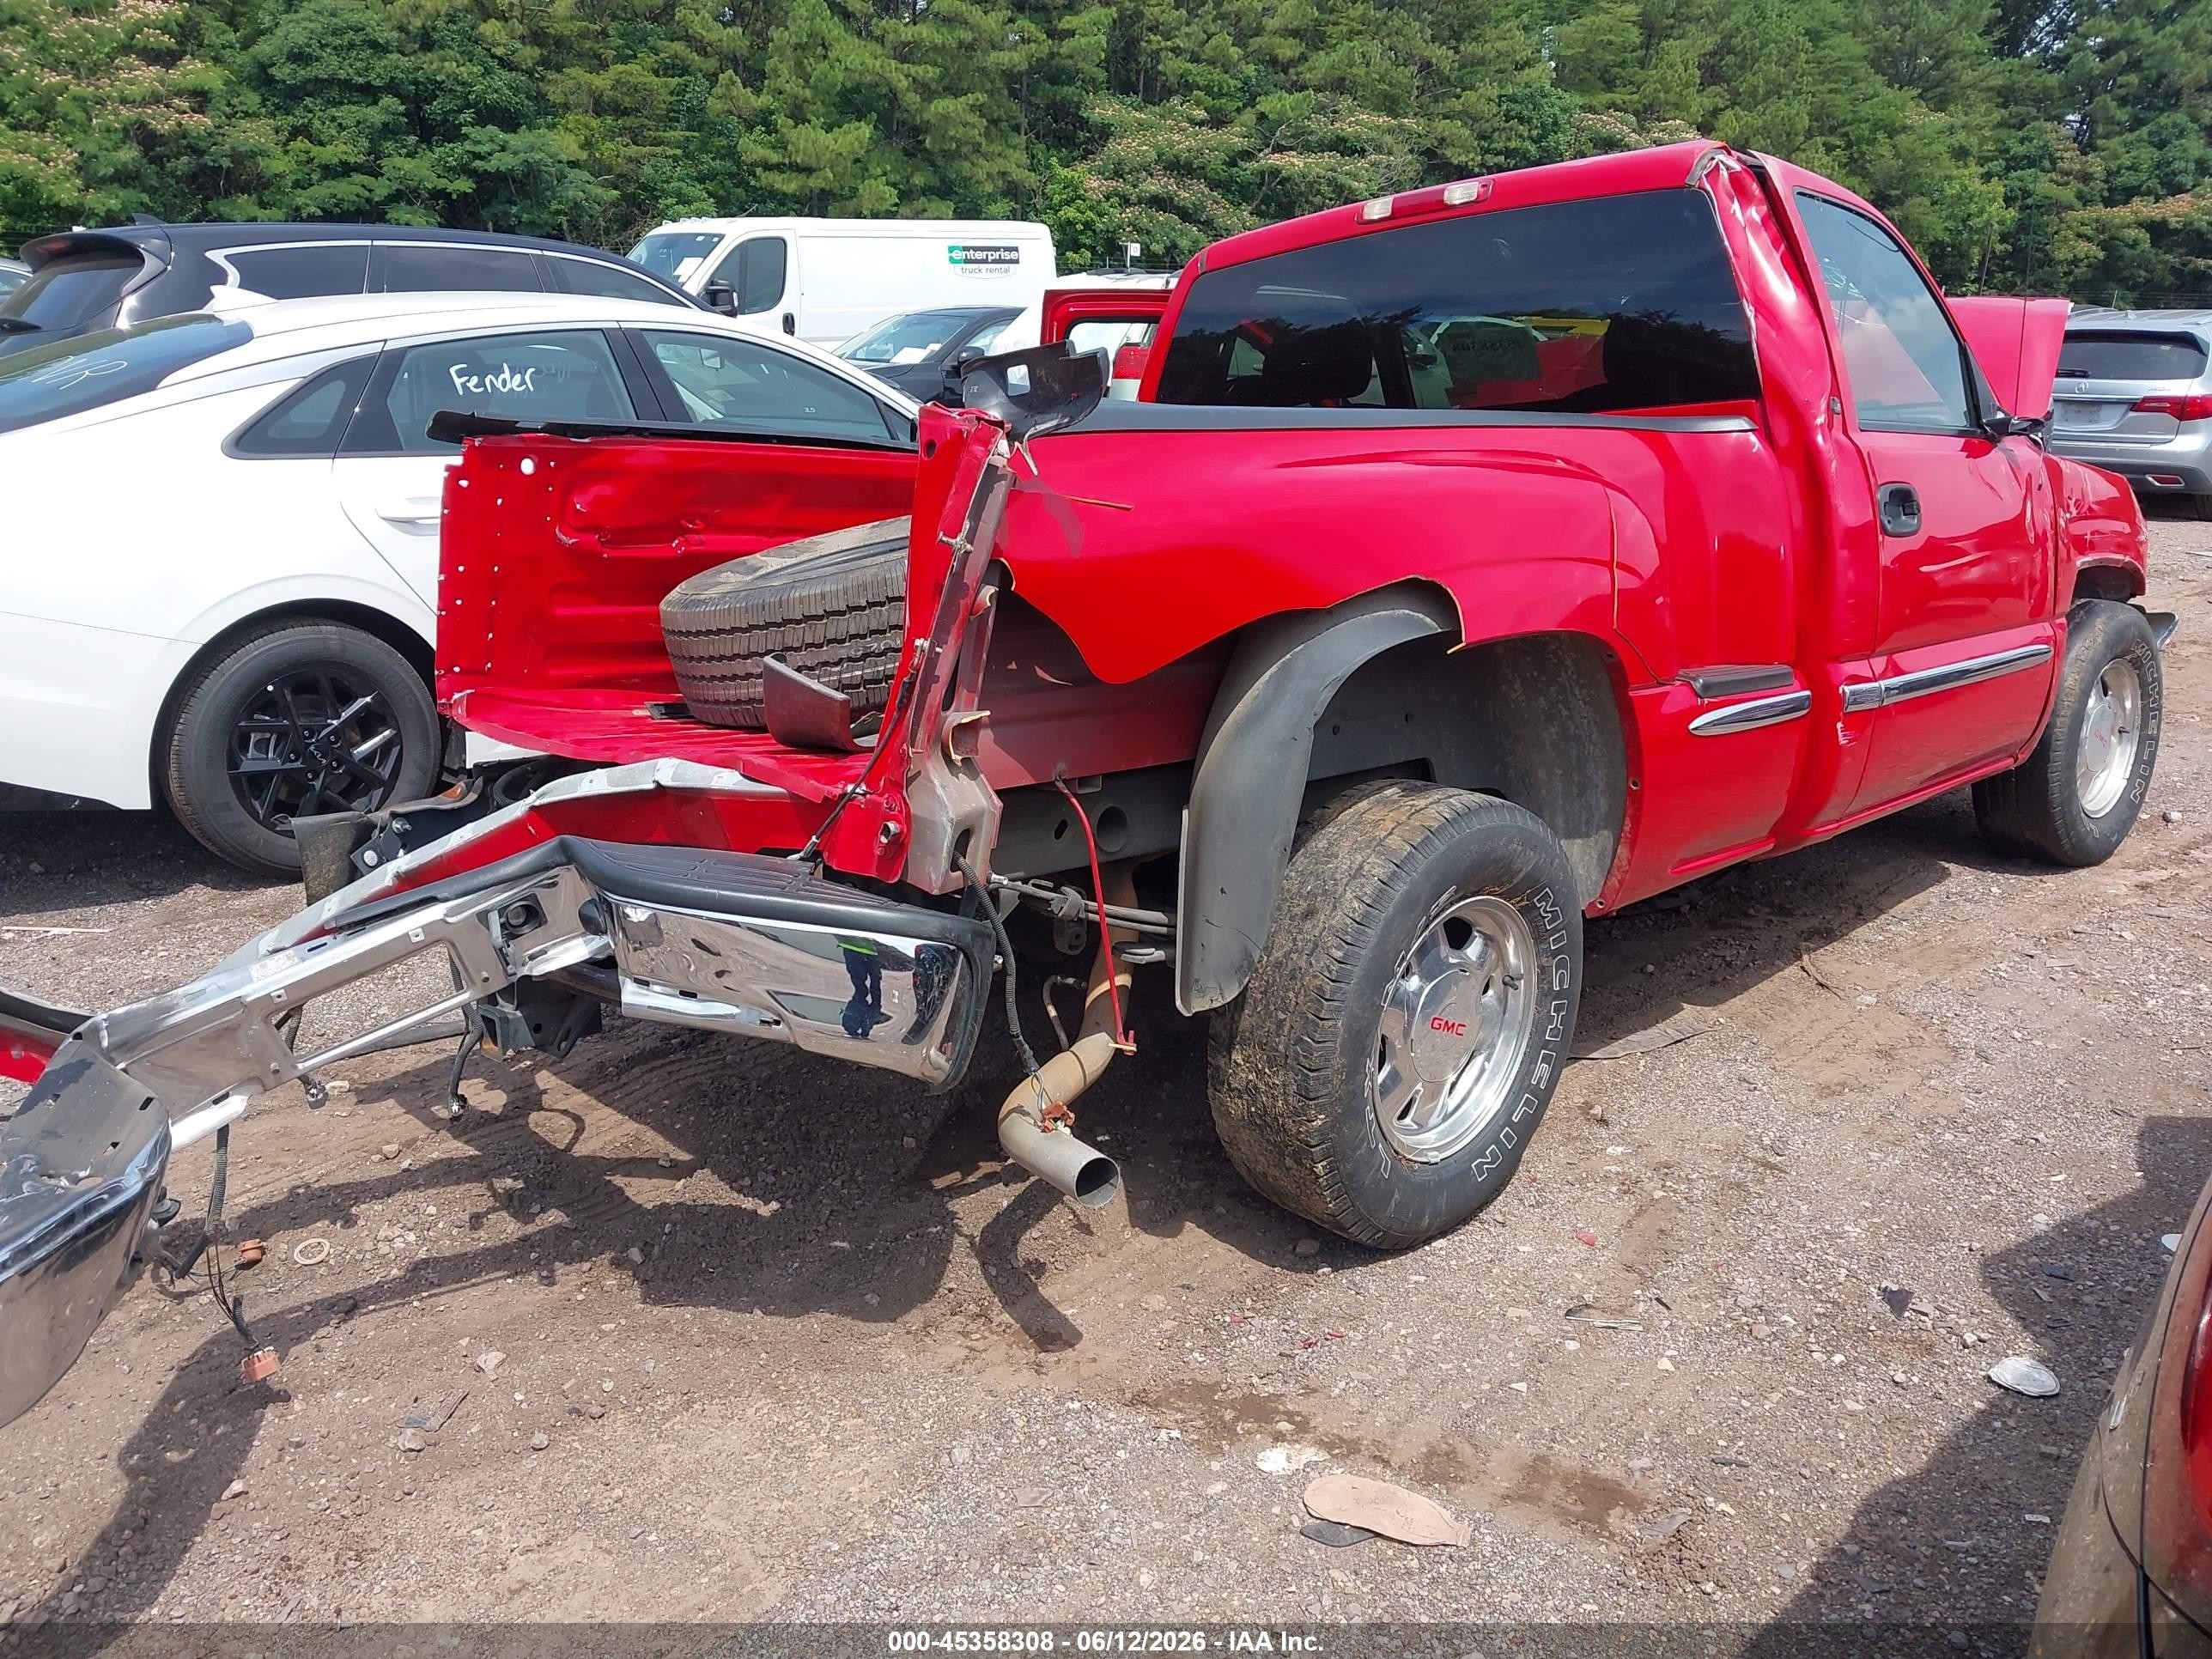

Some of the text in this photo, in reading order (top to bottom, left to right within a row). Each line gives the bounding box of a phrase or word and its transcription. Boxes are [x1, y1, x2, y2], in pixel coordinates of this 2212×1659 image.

[949, 247, 1019, 263] enterprise
[961, 265, 1011, 274] truck rental
[449, 362, 536, 395] Fender
[2130, 639, 2160, 805] MICHELIN
[2094, 729, 2108, 747] GMC
[1431, 1017, 1467, 1036] GMC
[1472, 887, 1571, 1182] MICHELIN
